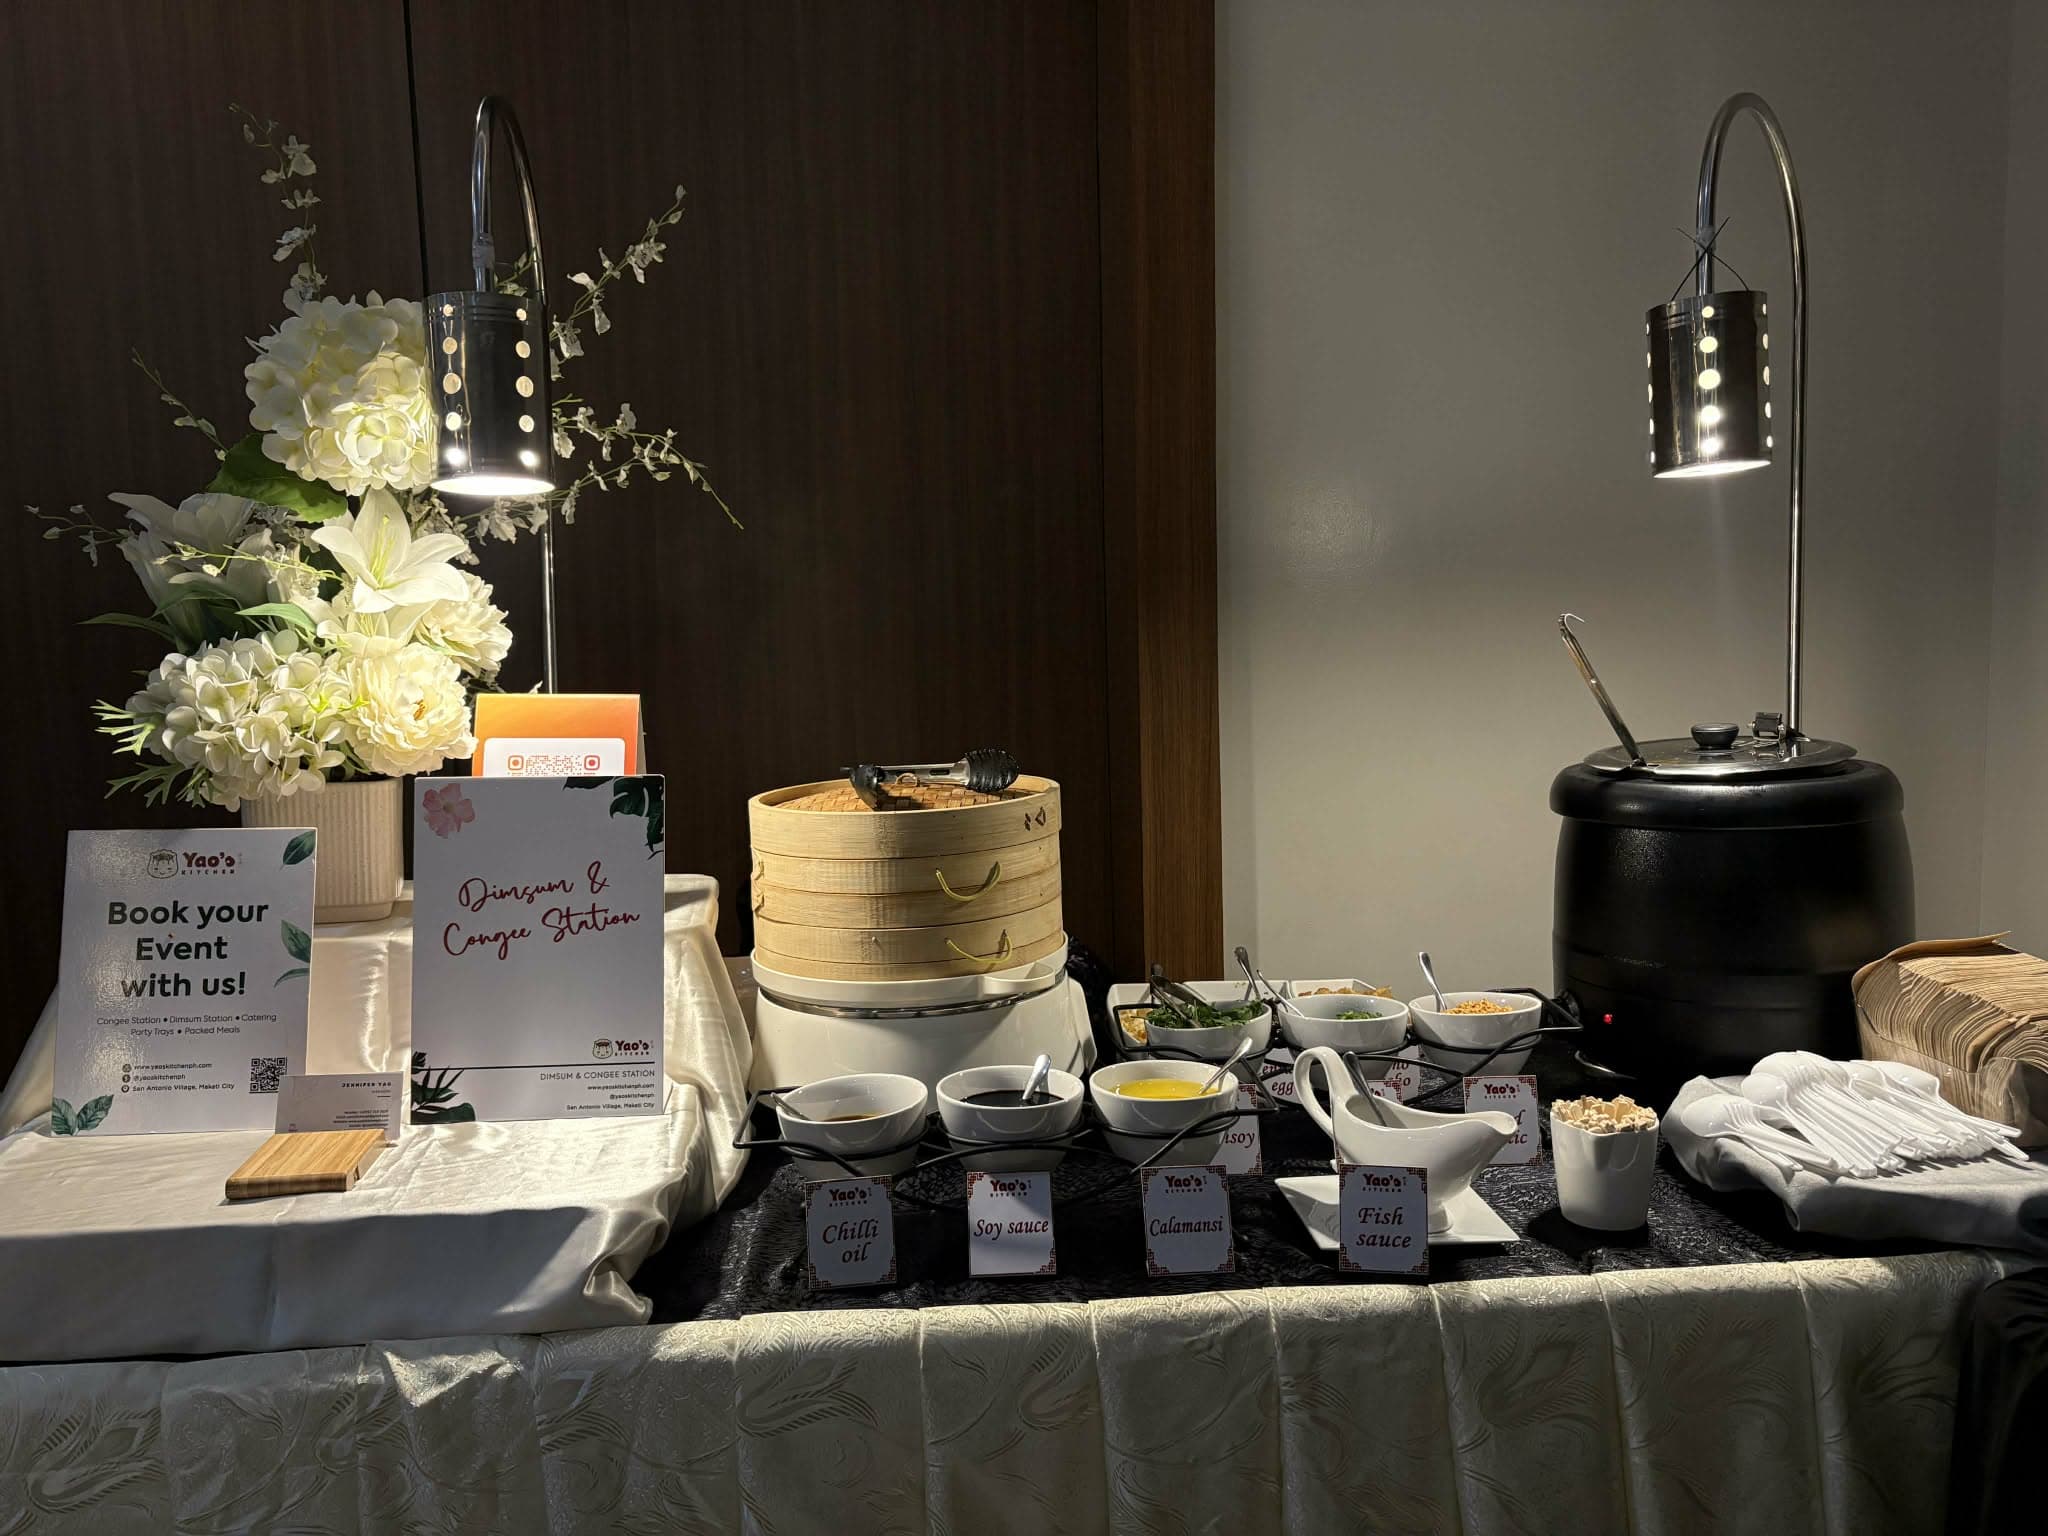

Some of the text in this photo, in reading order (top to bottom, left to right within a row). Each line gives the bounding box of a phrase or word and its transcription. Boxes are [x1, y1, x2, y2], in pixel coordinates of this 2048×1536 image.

[183, 852, 235, 868] Yao's
[458, 860, 610, 912] Dimsum &
[108, 900, 268, 929] Book your
[443, 903, 640, 960] Congee Station
[136, 936, 228, 960] Event
[121, 971, 246, 997] with us!
[97, 1013, 277, 1026] Congee Station Dimsum Station Catering
[130, 1025, 240, 1037] Party Trays Packed Meals
[615, 1039, 650, 1052] Yao's
[540, 1072, 573, 1081] DIMSUM
[584, 1071, 619, 1079] CONGEE
[622, 1070, 655, 1078] STATION
[1272, 1081, 1295, 1096] egg
[1484, 1083, 1516, 1095] Yao's
[990, 1179, 1027, 1192] Yao's
[1165, 1174, 1203, 1188] Yao's
[1363, 1173, 1402, 1187] Yao's
[829, 1186, 867, 1201] Yao's
[1358, 1206, 1403, 1226] Fish
[822, 1218, 879, 1244] Chilli
[973, 1218, 1049, 1240] Soy sauce
[1149, 1215, 1224, 1237] Calamansi
[1355, 1233, 1412, 1248] sauce
[842, 1241, 871, 1263] oil
